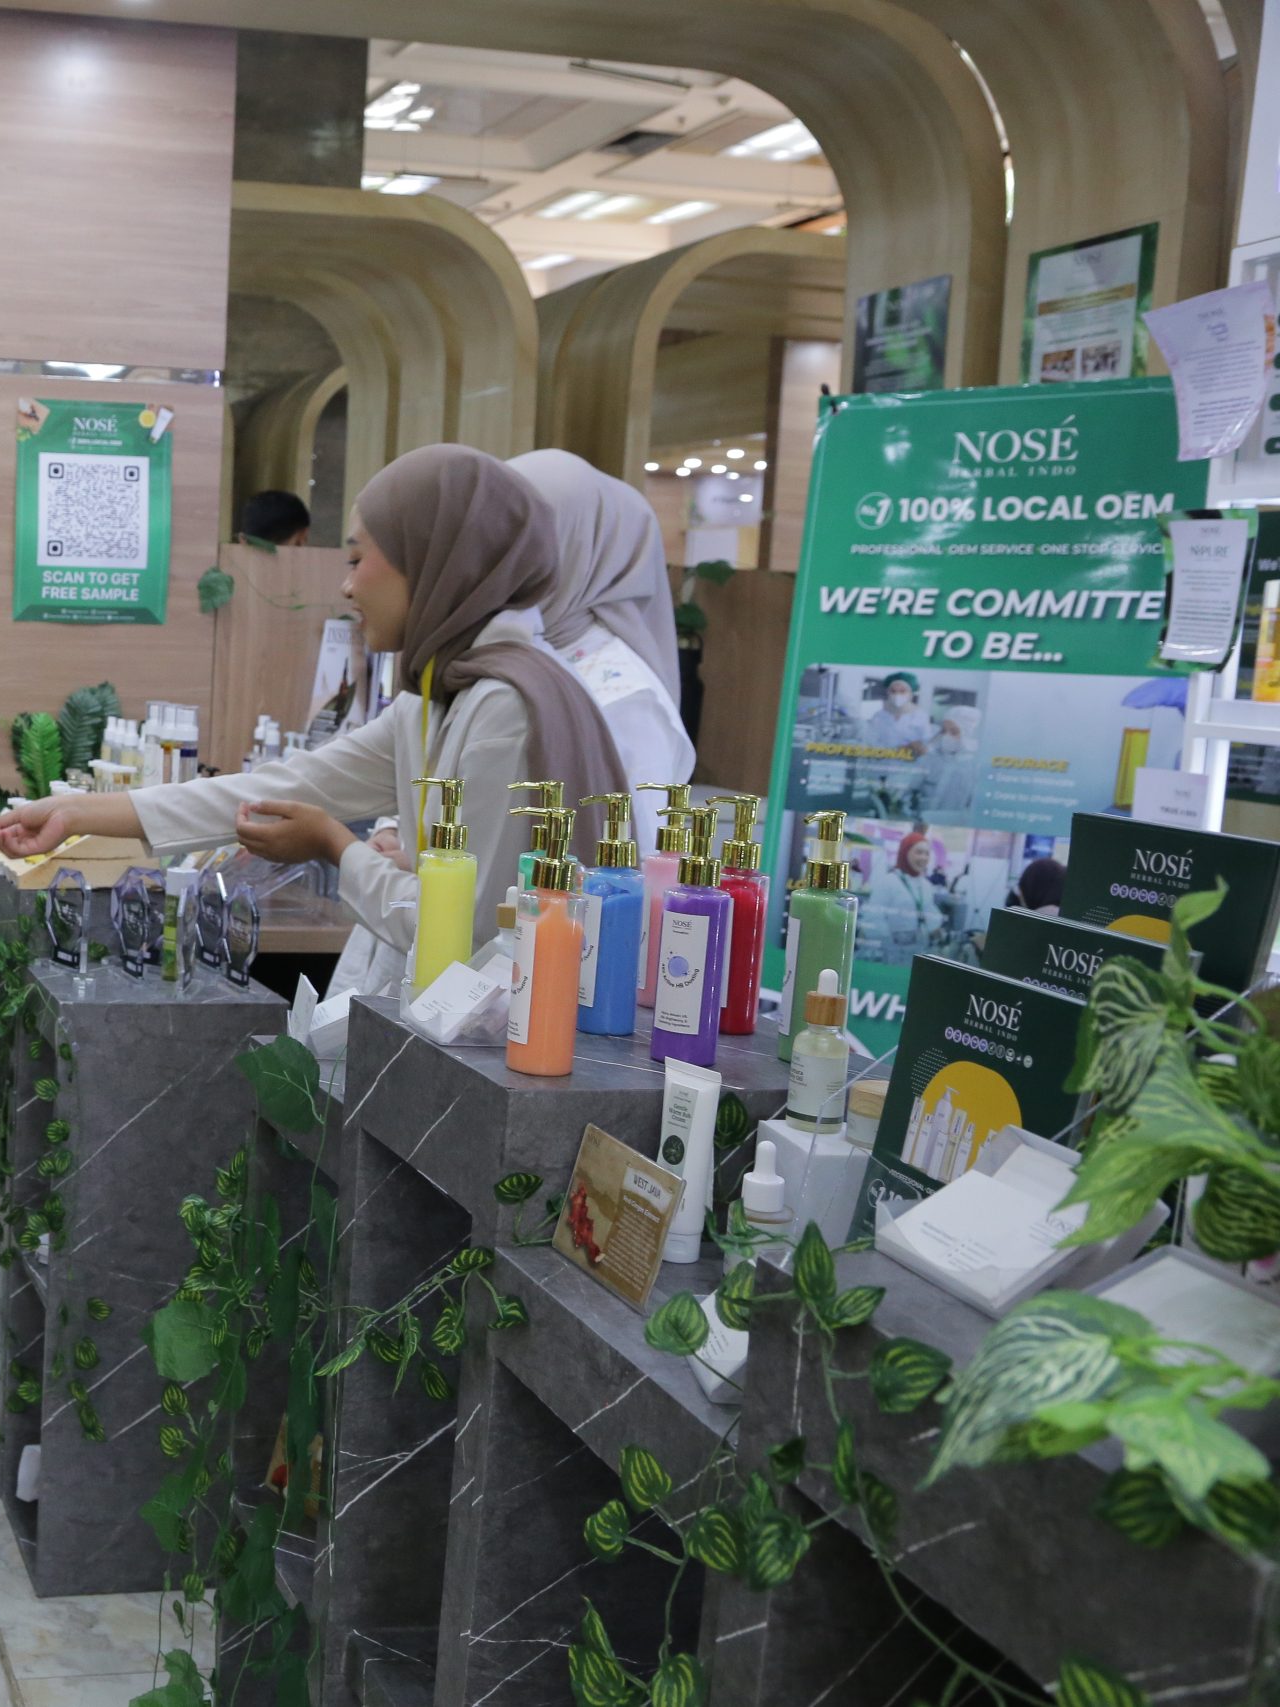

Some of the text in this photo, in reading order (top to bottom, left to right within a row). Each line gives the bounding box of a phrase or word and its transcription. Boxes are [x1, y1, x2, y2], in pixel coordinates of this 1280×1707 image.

[73, 414, 119, 432] NOSÉ
[951, 414, 1079, 464] NOSÉ
[949, 464, 1077, 478] HERBAL INDO
[898, 497, 976, 522] 100%
[982, 495, 1089, 522] LOCAL
[1095, 493, 1175, 520] OEM
[979, 543, 1034, 555] SERVICE
[1039, 543, 1071, 555] ONE
[1072, 543, 1108, 556] STOP
[1111, 543, 1165, 556] SERVIC
[42, 570, 140, 586] SCAN TO GET
[41, 585, 139, 601] FREE SAMPLE
[820, 586, 1166, 621] WE'RE COMMITTE
[922, 630, 1063, 662] TO BE...
[806, 742, 915, 761] PROFESSIONAL
[991, 756, 1069, 773] COURAGE
[1132, 848, 1194, 880] NOSÉ
[966, 993, 1022, 1032] NOSÉ
